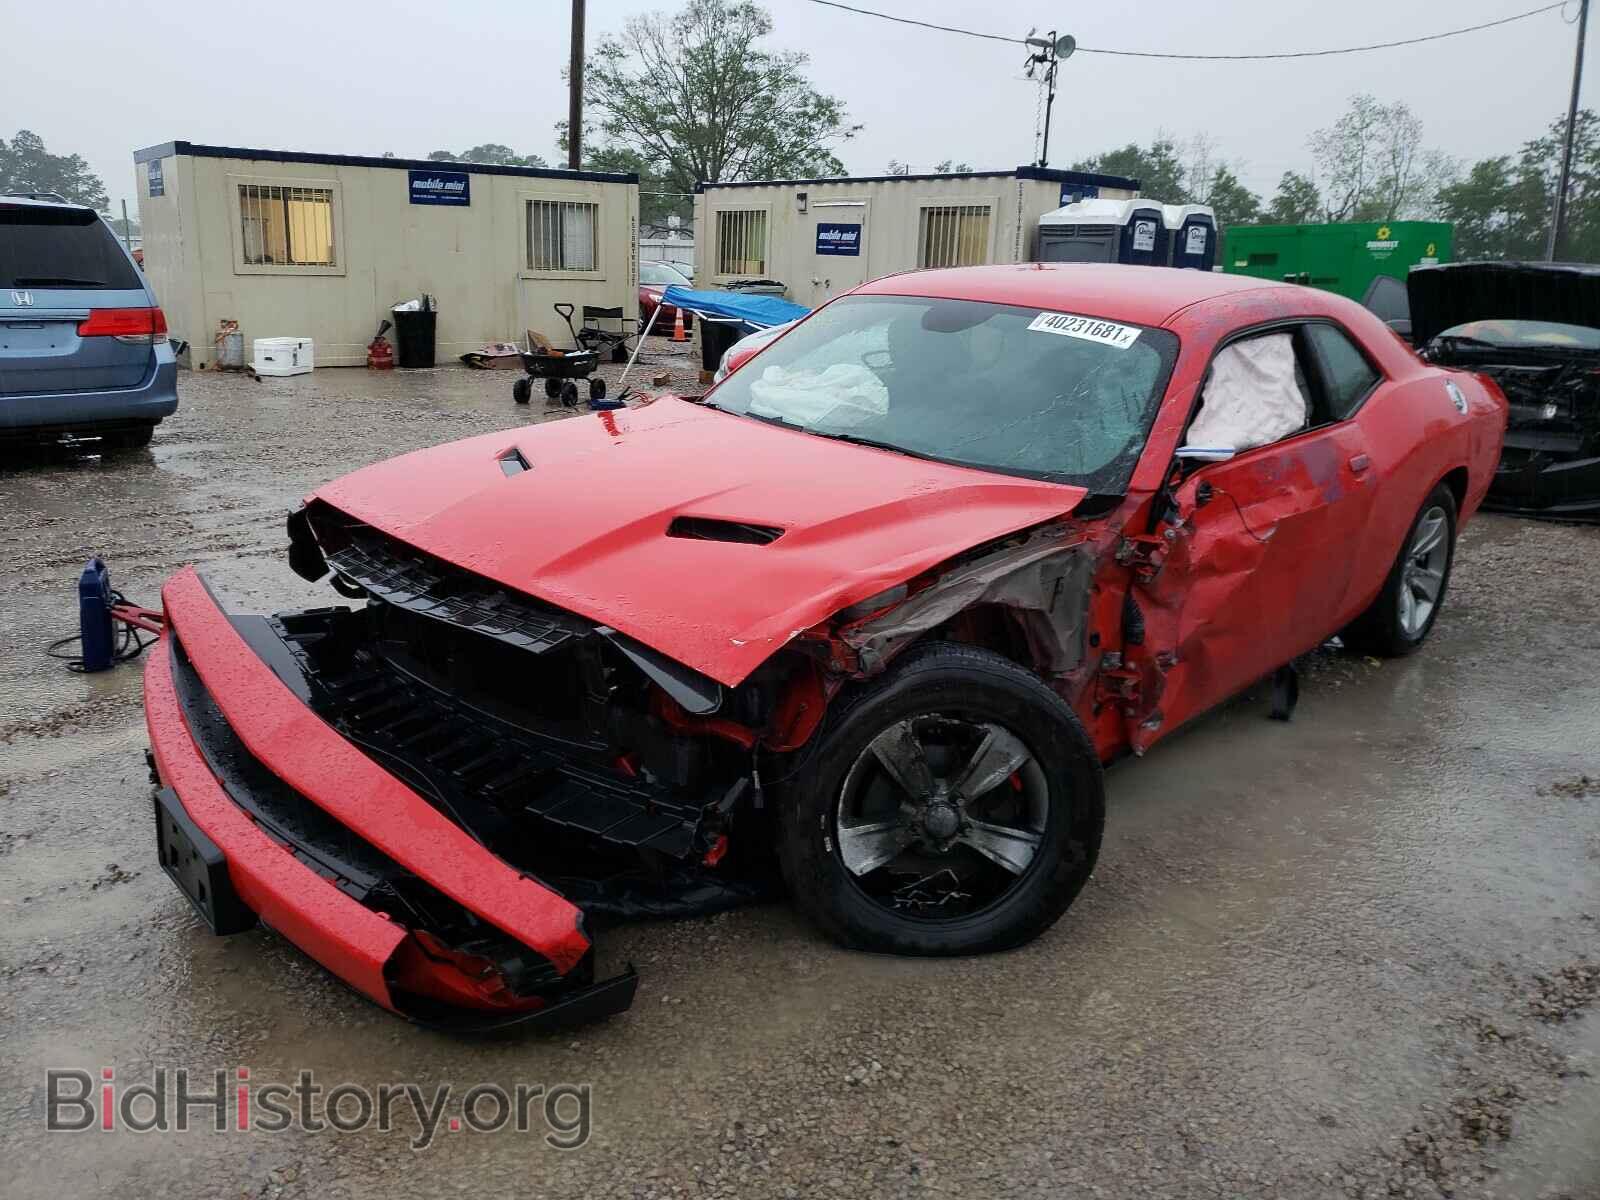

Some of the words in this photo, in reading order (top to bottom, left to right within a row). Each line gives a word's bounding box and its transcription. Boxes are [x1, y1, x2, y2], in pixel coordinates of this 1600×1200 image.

[412, 178, 443, 189] mobile
[444, 180, 465, 191] mini
[818, 229, 841, 240] mobile
[841, 231, 858, 241] mini
[1045, 315, 1124, 341] 40231681
